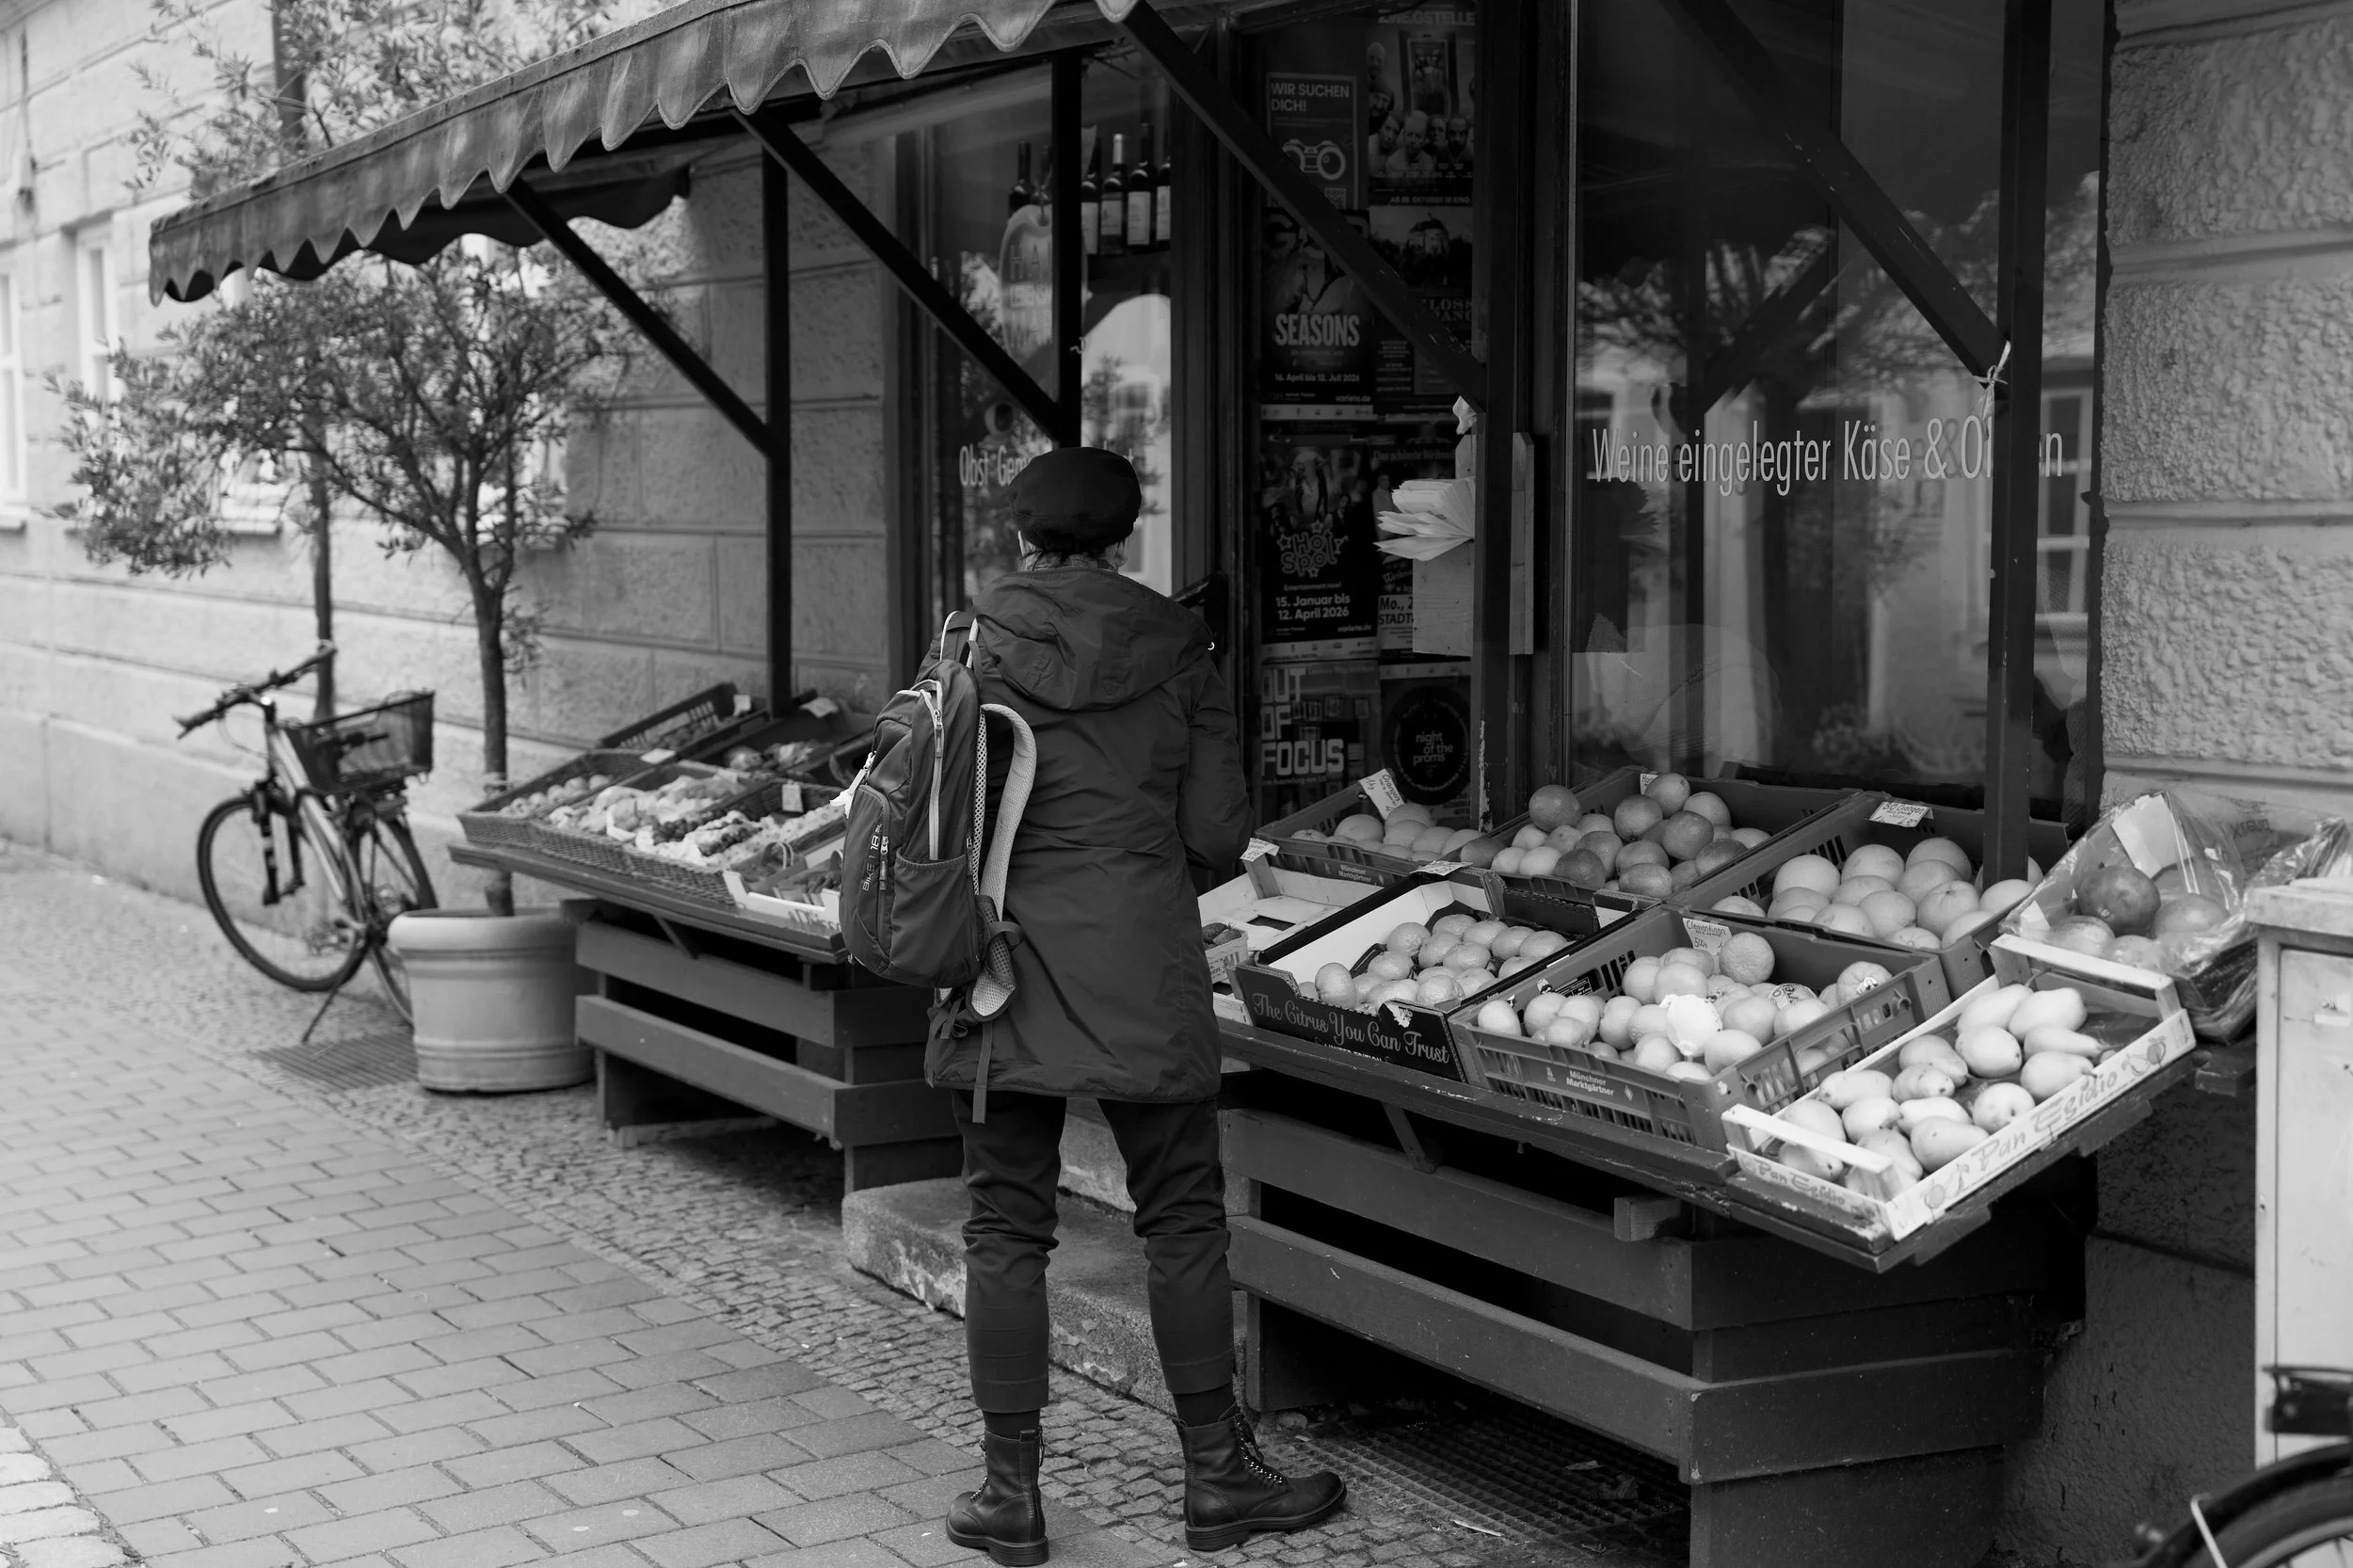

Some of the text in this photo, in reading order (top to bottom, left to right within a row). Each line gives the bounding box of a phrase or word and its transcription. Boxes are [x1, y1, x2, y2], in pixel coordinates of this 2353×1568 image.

[1271, 82, 1350, 98] WIR SUCHEN
[1271, 98, 1306, 112] DICH!
[1275, 313, 1360, 346] SEASONS
[960, 443, 988, 487] Obst
[1593, 428, 1669, 482] Weine
[1679, 420, 1831, 496] eingelegter
[1844, 420, 1911, 481] Käse
[1925, 418, 1946, 479] &
[1275, 593, 1351, 607] 15. Januar bis
[1277, 606, 1350, 621] 12. April 2026
[1261, 667, 1306, 703] OUT
[1260, 704, 1291, 740] OF
[1416, 730, 1443, 745] night
[1423, 742, 1453, 755] of the
[1262, 738, 1344, 776] FOCUS
[1413, 753, 1446, 767] proms
[863, 863, 874, 891] BIKE
[871, 835, 879, 850] 18
[1687, 920, 1726, 936] Clementinen
[1253, 993, 1282, 1020] The
[1285, 1000, 1328, 1033] Citrus
[1329, 1012, 1365, 1046] You
[1368, 1021, 1401, 1052] Can
[1403, 1031, 1449, 1064] Trust
[1566, 1078, 1614, 1096] Marktgärtner
[1569, 1070, 1607, 1086] Münchner
[1972, 1072, 2118, 1171] Pan Egidio
[1754, 1158, 1787, 1184] Pan
